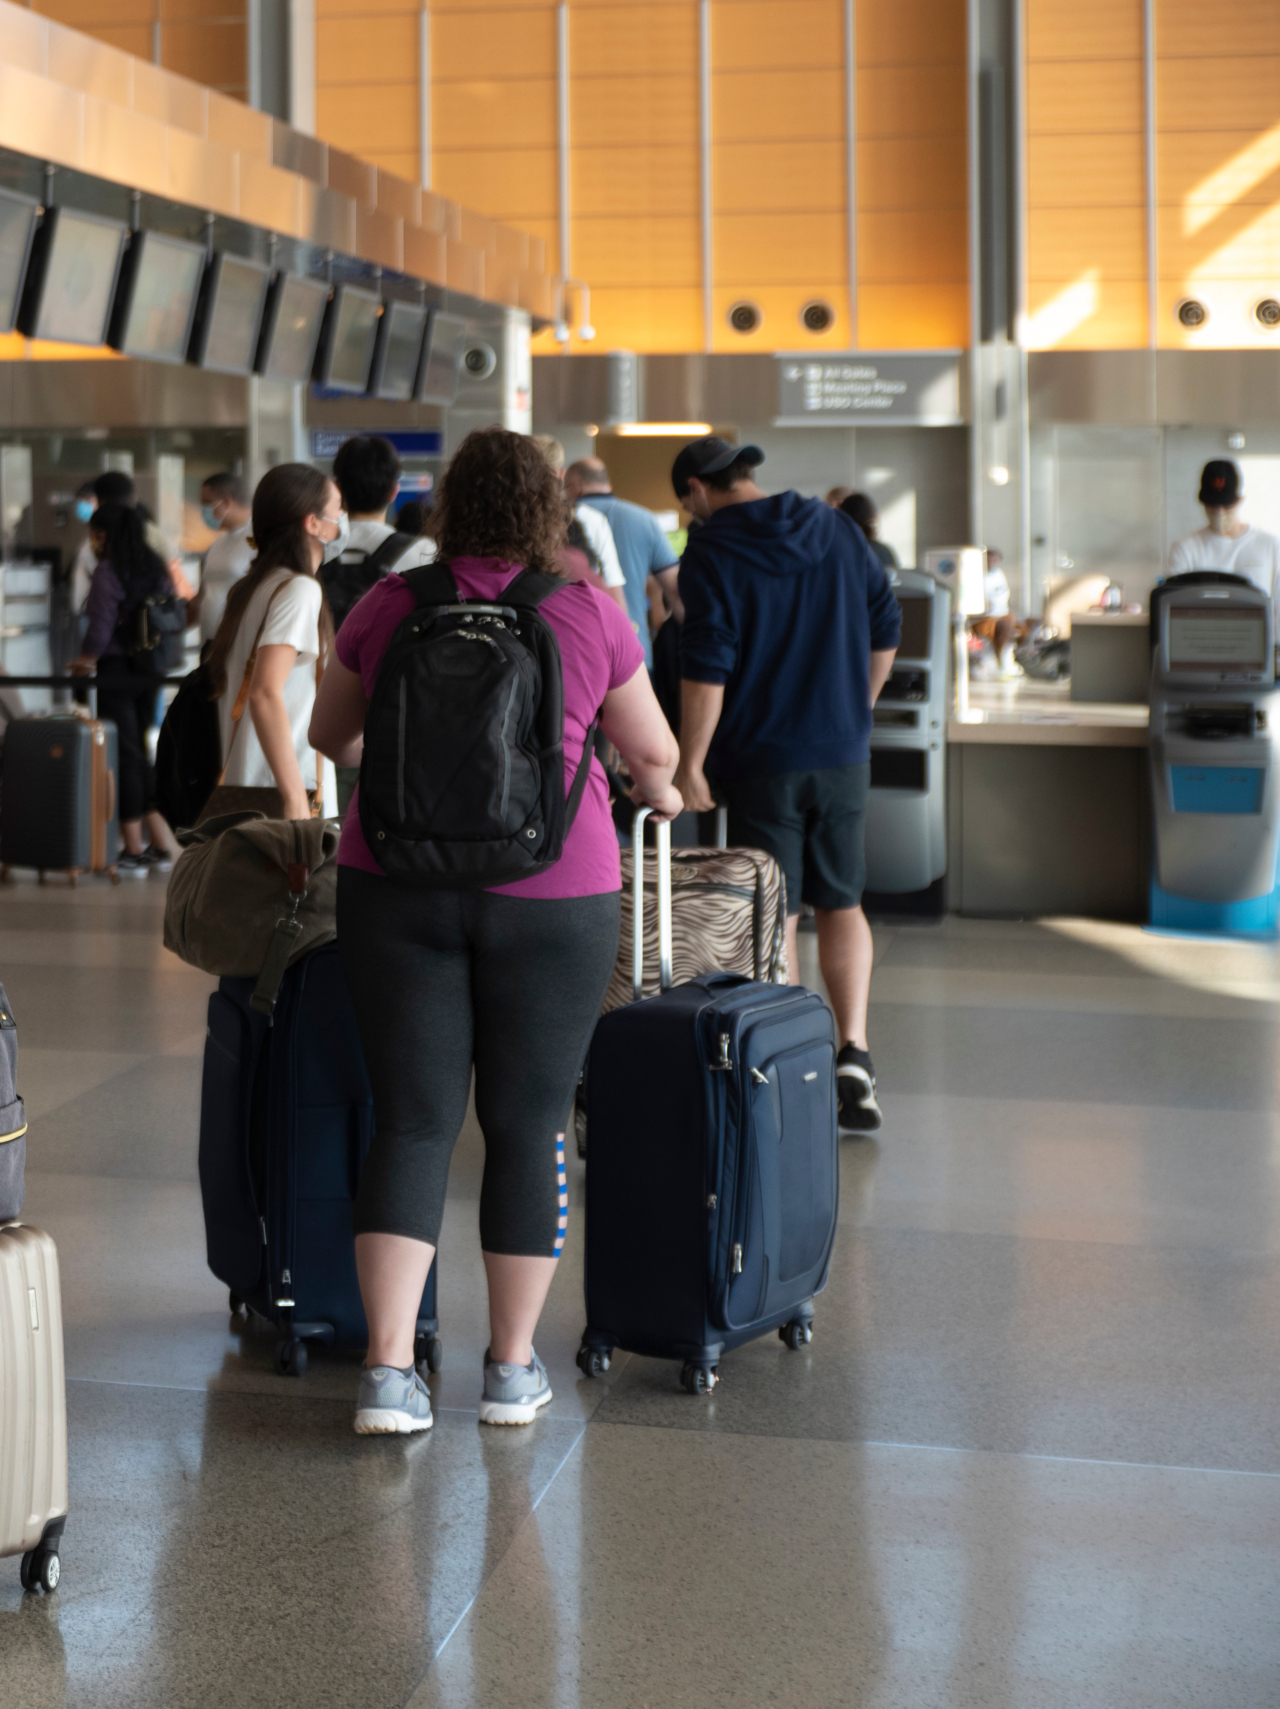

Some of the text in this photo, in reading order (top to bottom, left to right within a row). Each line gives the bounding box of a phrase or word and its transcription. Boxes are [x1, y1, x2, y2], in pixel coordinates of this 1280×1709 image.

[842, 366, 877, 380] Gates
[824, 381, 907, 396] Meeting Place
[852, 396, 893, 409] Center
